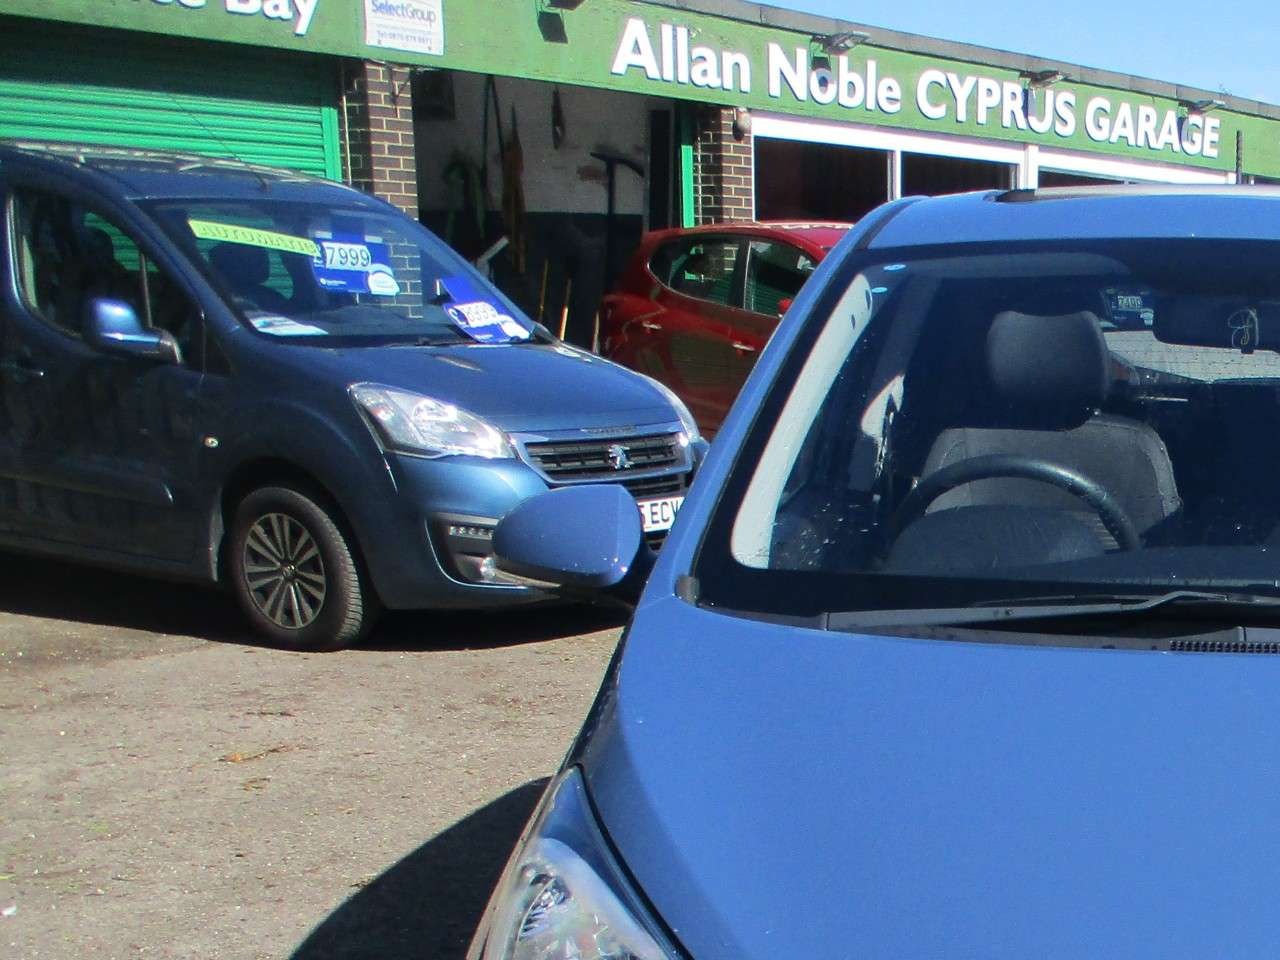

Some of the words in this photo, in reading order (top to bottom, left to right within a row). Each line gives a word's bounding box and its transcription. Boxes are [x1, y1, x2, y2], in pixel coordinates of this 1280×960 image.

[610, 17, 751, 94] Allan
[767, 42, 902, 114] Noble
[915, 68, 1077, 138] CYPRUS
[1084, 95, 1221, 159] GARAGE
[327, 244, 371, 268] 7999
[650, 499, 679, 525] ECV
